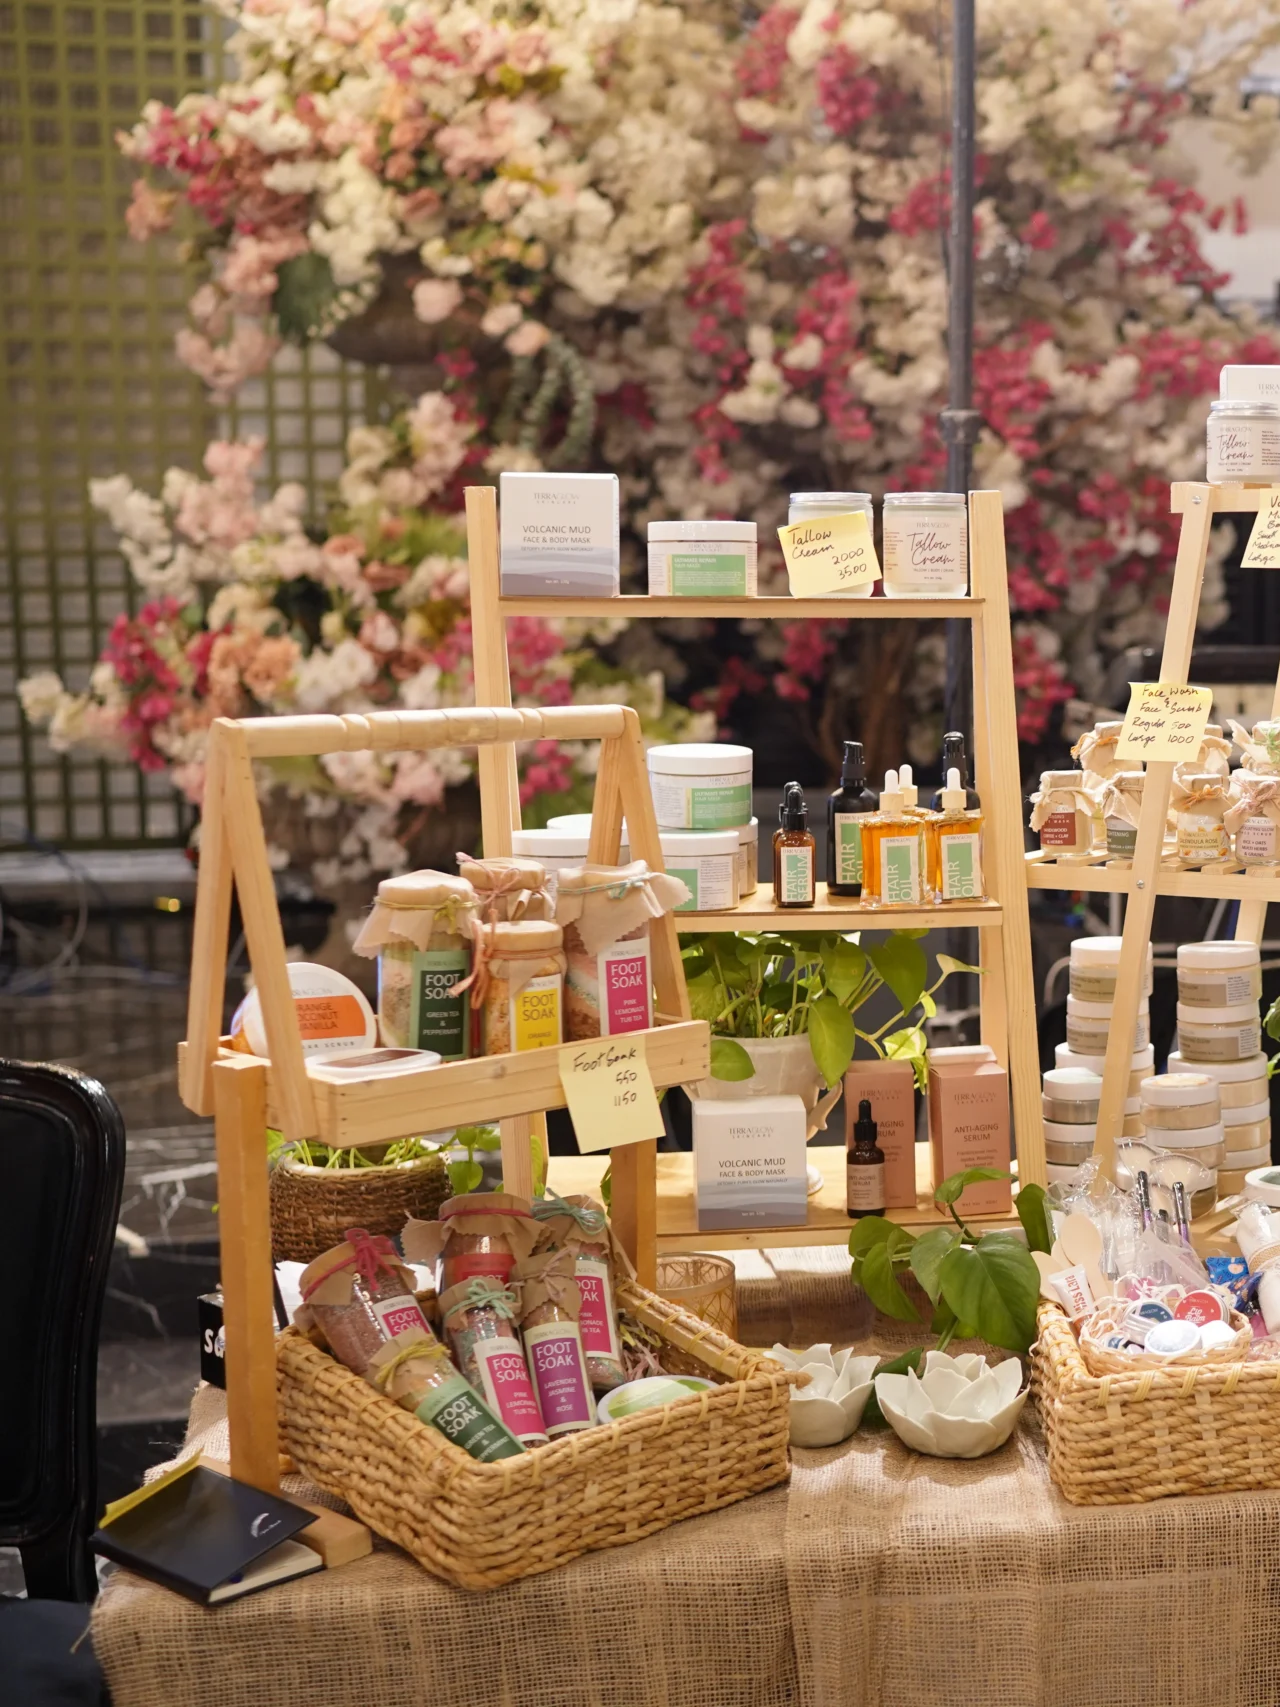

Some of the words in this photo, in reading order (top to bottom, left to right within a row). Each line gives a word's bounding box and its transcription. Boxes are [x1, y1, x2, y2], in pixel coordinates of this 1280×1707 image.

[522, 525, 567, 535] VOLCANIC
[570, 526, 592, 535] MUD
[787, 527, 833, 546] Tallow
[523, 536, 540, 544] FACE
[541, 536, 549, 544] &
[549, 536, 569, 544] BODY
[571, 536, 592, 544] MASK
[907, 532, 953, 553] Tallow
[792, 544, 835, 560] Cream
[832, 547, 865, 566] 2000
[911, 546, 956, 567] Cream
[838, 563, 868, 581] 3500
[1142, 684, 1167, 698] Face
[1170, 688, 1199, 696] Wash
[1140, 702, 1162, 713] Face
[1169, 703, 1202, 715] Scrub
[1171, 721, 1192, 731] 500
[1128, 733, 1156, 749] Large
[1168, 734, 1194, 744] 1000
[841, 843, 856, 884] HAIR
[786, 869, 798, 901] HAIR
[797, 854, 808, 901] SERUM
[887, 864, 899, 903] HAIR
[900, 880, 914, 903] OIL
[947, 860, 960, 899] HAIR
[961, 871, 975, 898] OIL
[611, 961, 643, 976] FOOT
[424, 973, 460, 987] FOOT
[611, 974, 644, 989] SOAK
[523, 993, 555, 1008] FOOT
[623, 998, 637, 1007] PINK
[523, 1006, 556, 1022] SOAK
[620, 1015, 632, 1023] TUB
[573, 1051, 607, 1073] Foot
[606, 1046, 637, 1068] Soak
[616, 1069, 638, 1085] 550
[614, 1090, 637, 1107] 1150
[954, 1123, 999, 1134] ANTI-AGING
[963, 1133, 991, 1142] SERUM
[718, 1158, 762, 1168] VOLCANIC
[764, 1157, 786, 1166] MUD
[719, 1170, 737, 1178] FACE
[738, 1170, 744, 1178] &
[745, 1169, 764, 1177] BODY
[765, 1168, 786, 1176] MASK
[389, 1310, 418, 1326] FOOT
[535, 1342, 572, 1360] FOOT
[491, 1357, 524, 1372] FOOT
[538, 1354, 575, 1373] SOAK
[495, 1369, 528, 1384] SOAK
[544, 1377, 578, 1390] LAVENDER
[548, 1387, 576, 1398] JASMINE
[437, 1396, 472, 1428] FOOT
[556, 1403, 574, 1413] ROSE
[446, 1405, 483, 1438] SOAK
